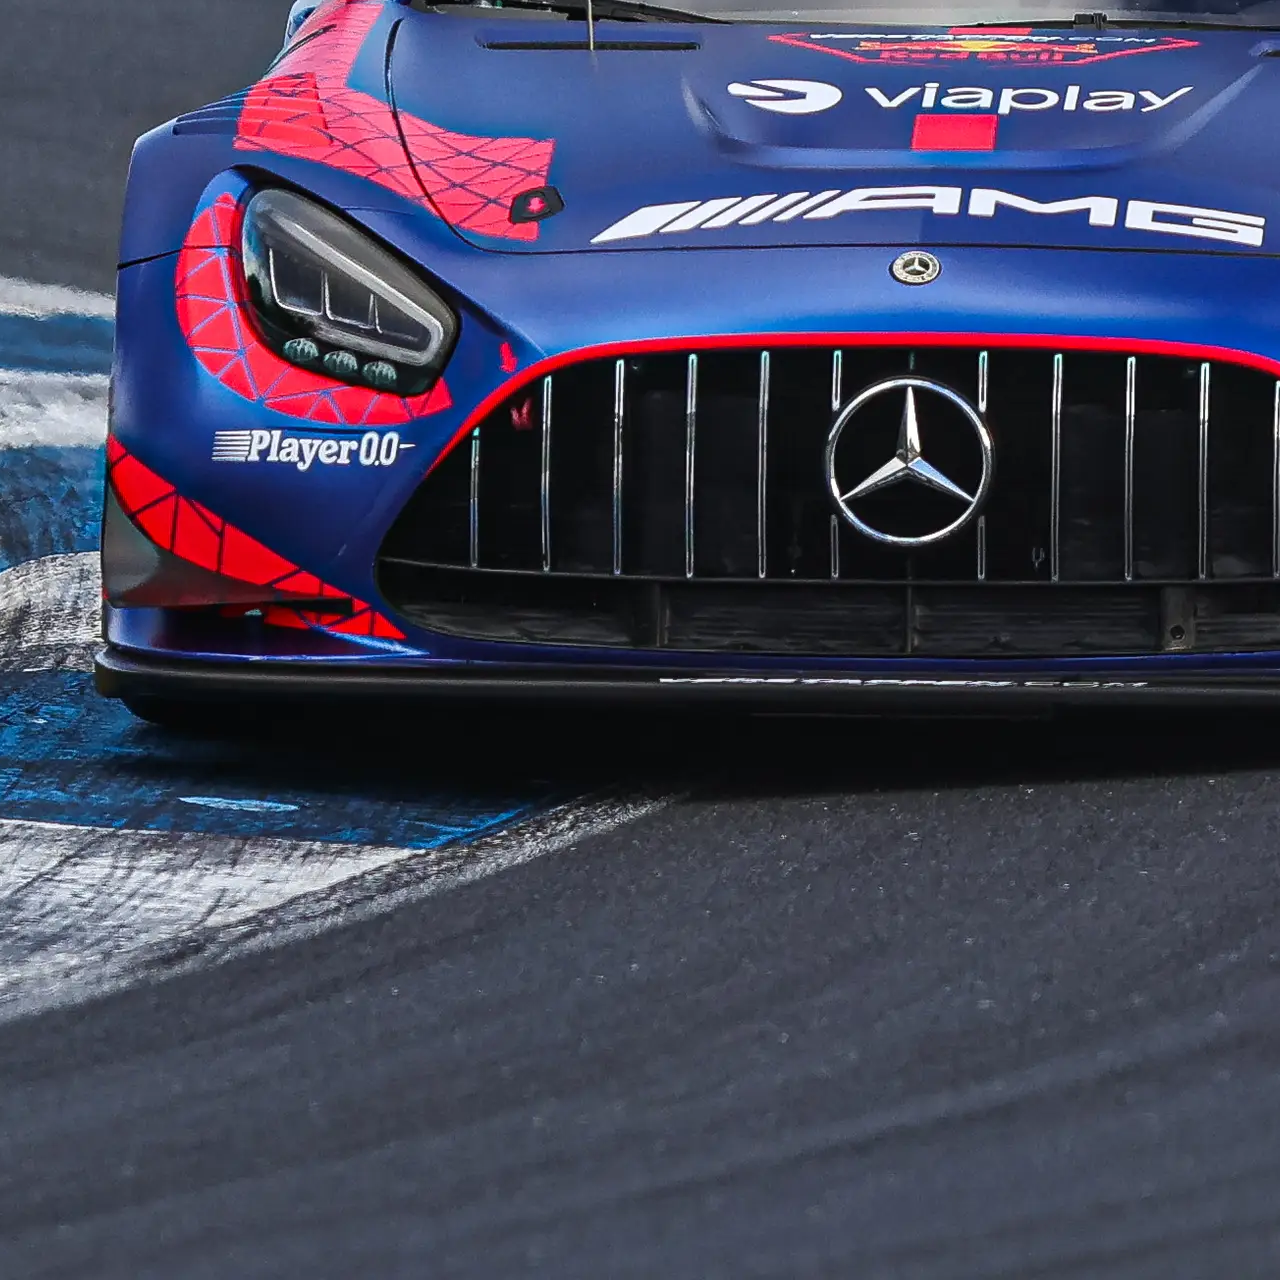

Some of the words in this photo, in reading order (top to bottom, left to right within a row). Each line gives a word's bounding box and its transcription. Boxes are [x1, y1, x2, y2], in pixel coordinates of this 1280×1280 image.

[864, 82, 1194, 115] viaplay
[802, 185, 1266, 247] AMG
[246, 429, 360, 471] Player
